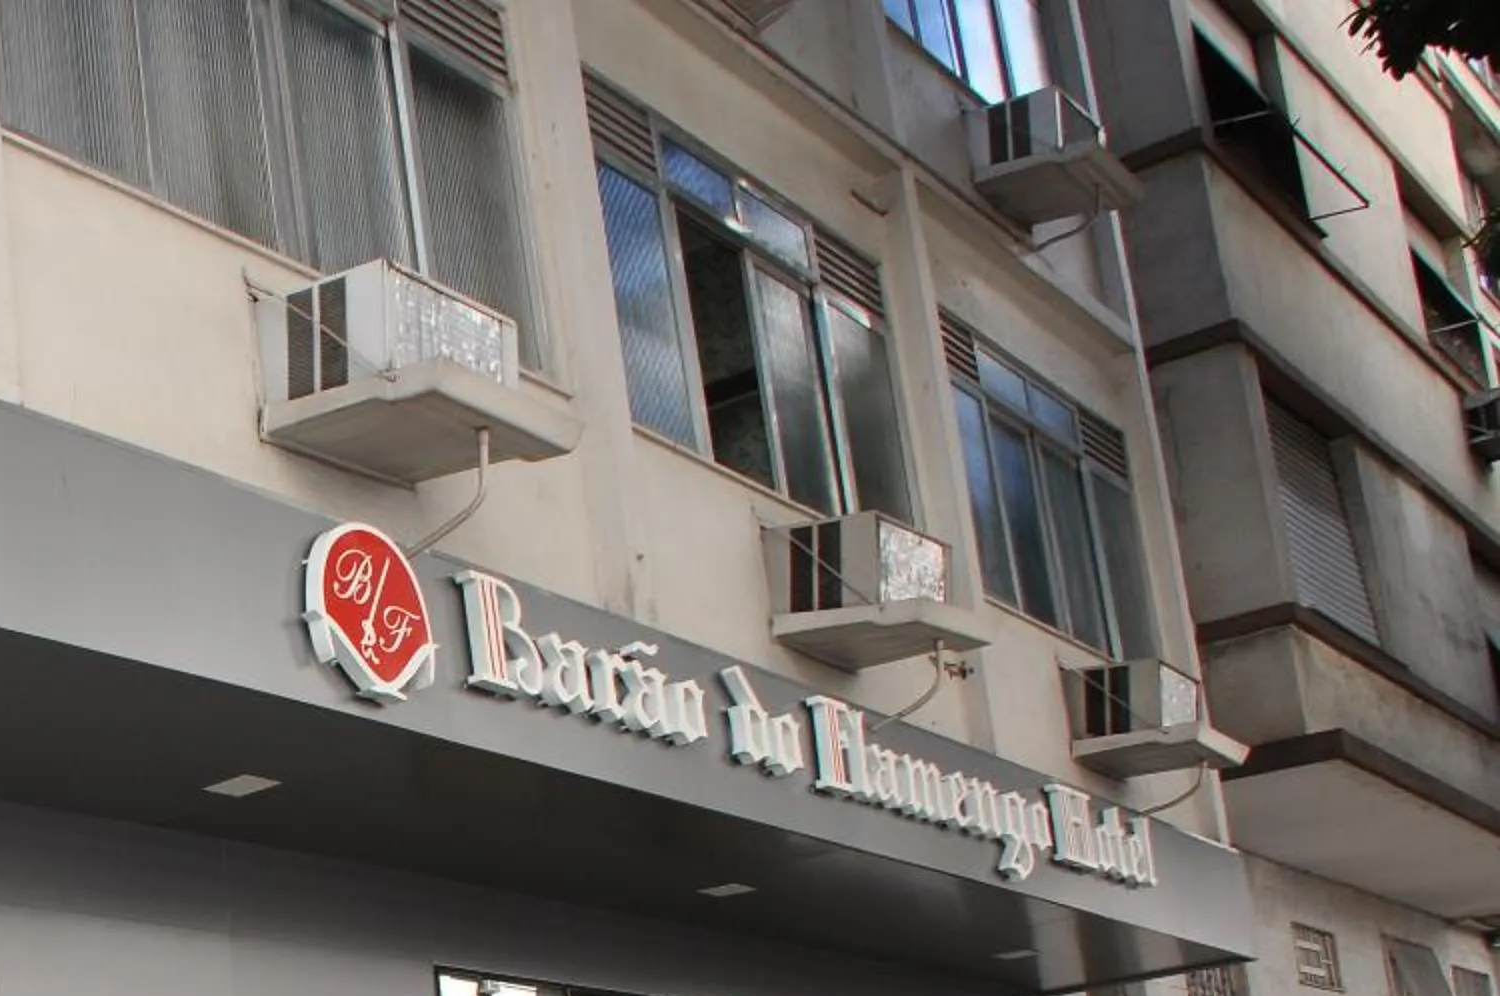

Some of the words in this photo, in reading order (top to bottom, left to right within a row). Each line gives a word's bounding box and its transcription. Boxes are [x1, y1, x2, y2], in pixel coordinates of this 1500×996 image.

[333, 548, 373, 605] B
[454, 569, 708, 747] Barão
[720, 665, 804, 777] do
[806, 695, 1053, 881] Flamengo
[1043, 783, 1158, 889] Hotel
